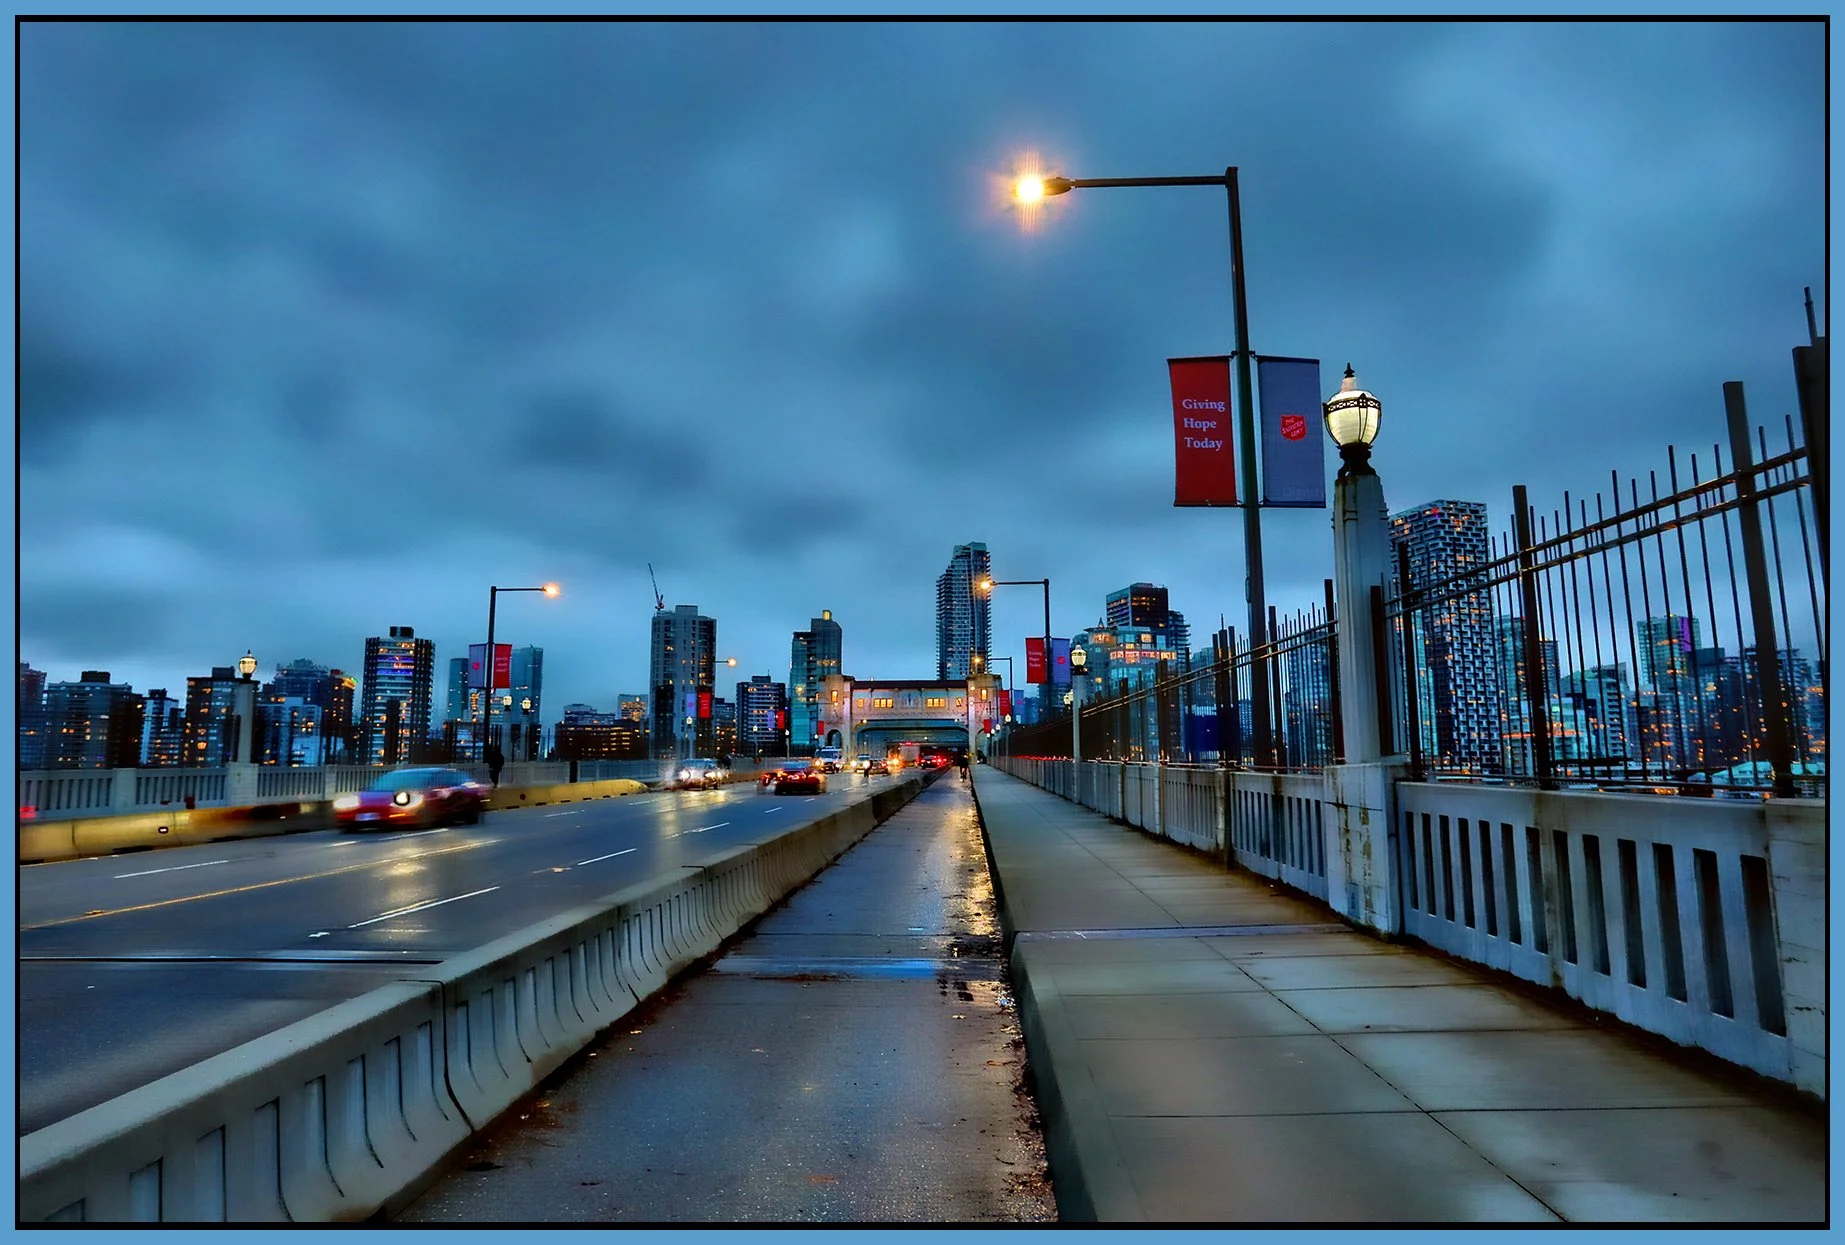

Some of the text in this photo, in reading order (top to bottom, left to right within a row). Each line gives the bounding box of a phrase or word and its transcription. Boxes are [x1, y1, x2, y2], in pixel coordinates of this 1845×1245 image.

[1182, 399, 1226, 412] Giving
[1183, 418, 1217, 431] Hope
[1184, 437, 1223, 451] Today
